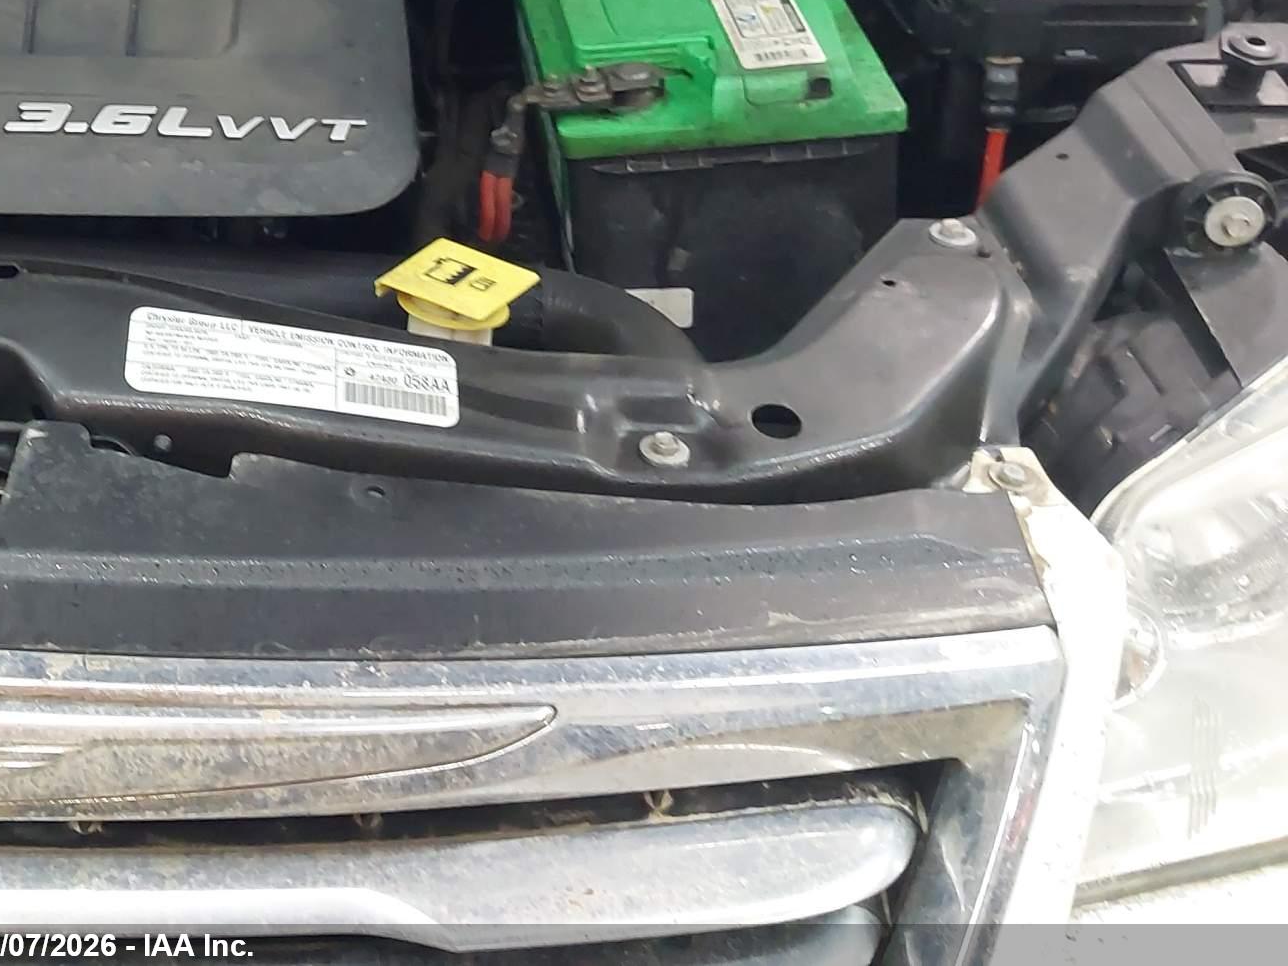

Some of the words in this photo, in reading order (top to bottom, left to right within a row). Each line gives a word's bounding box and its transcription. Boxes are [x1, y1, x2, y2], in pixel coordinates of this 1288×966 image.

[3, 101, 214, 138] 3.6L
[216, 113, 368, 142] VVT
[219, 322, 239, 332] LLC
